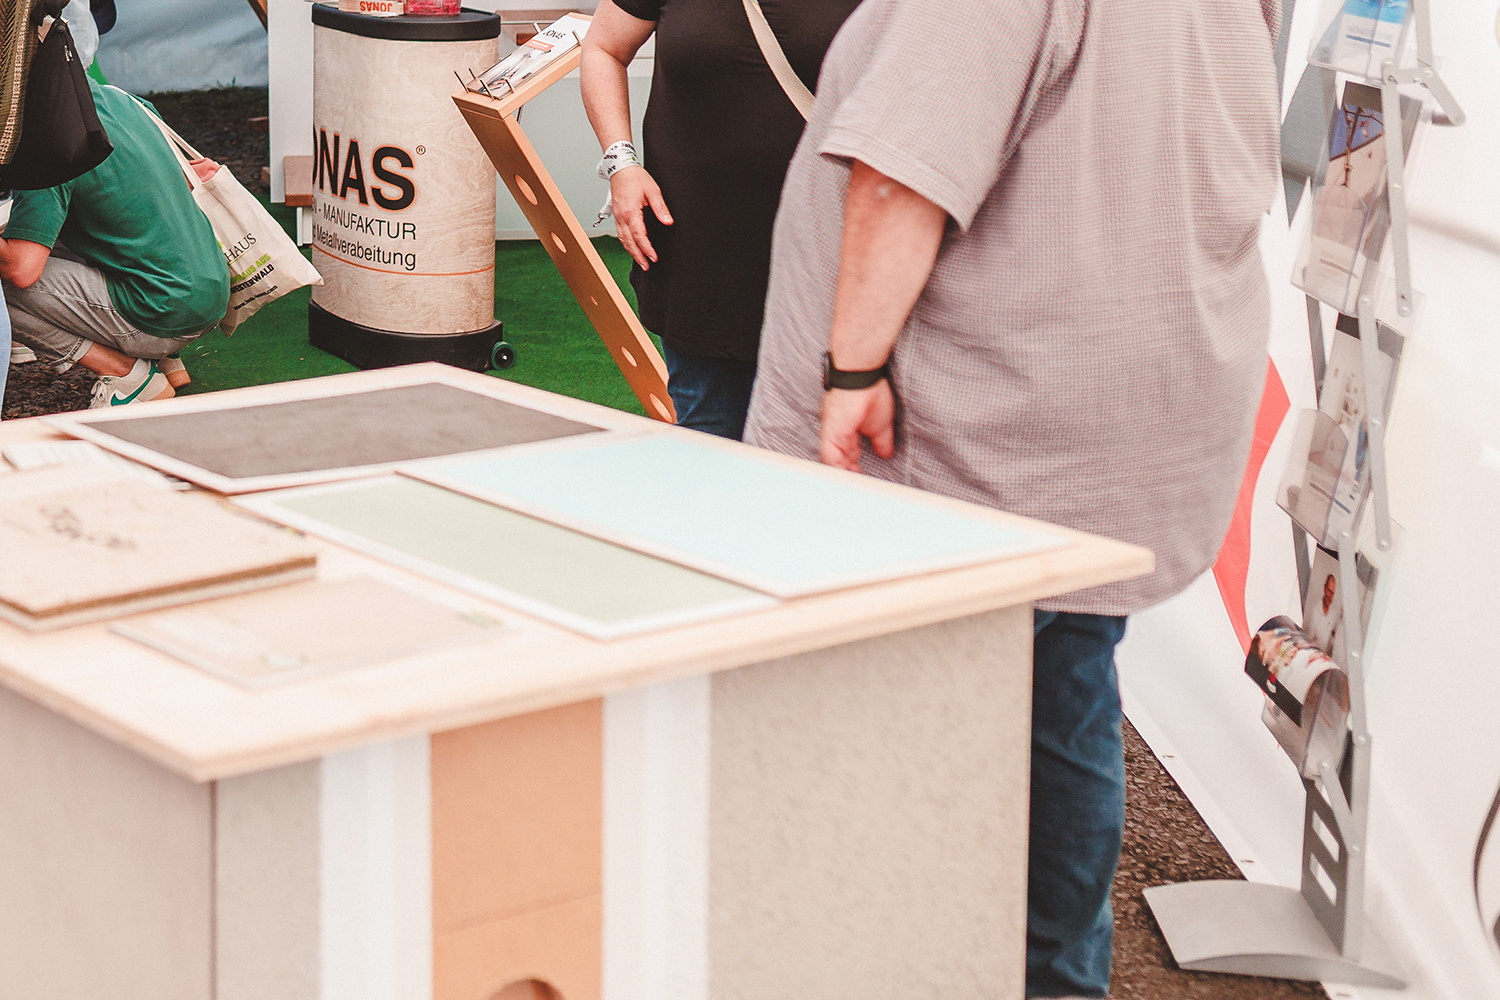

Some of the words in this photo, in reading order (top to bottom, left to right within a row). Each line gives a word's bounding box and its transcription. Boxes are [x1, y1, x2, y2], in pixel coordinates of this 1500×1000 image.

[360, 0, 393, 12] JONAS
[323, 202, 417, 241] MANUFAKTUR
[224, 232, 257, 263] HAUS
[255, 252, 271, 269] AUS
